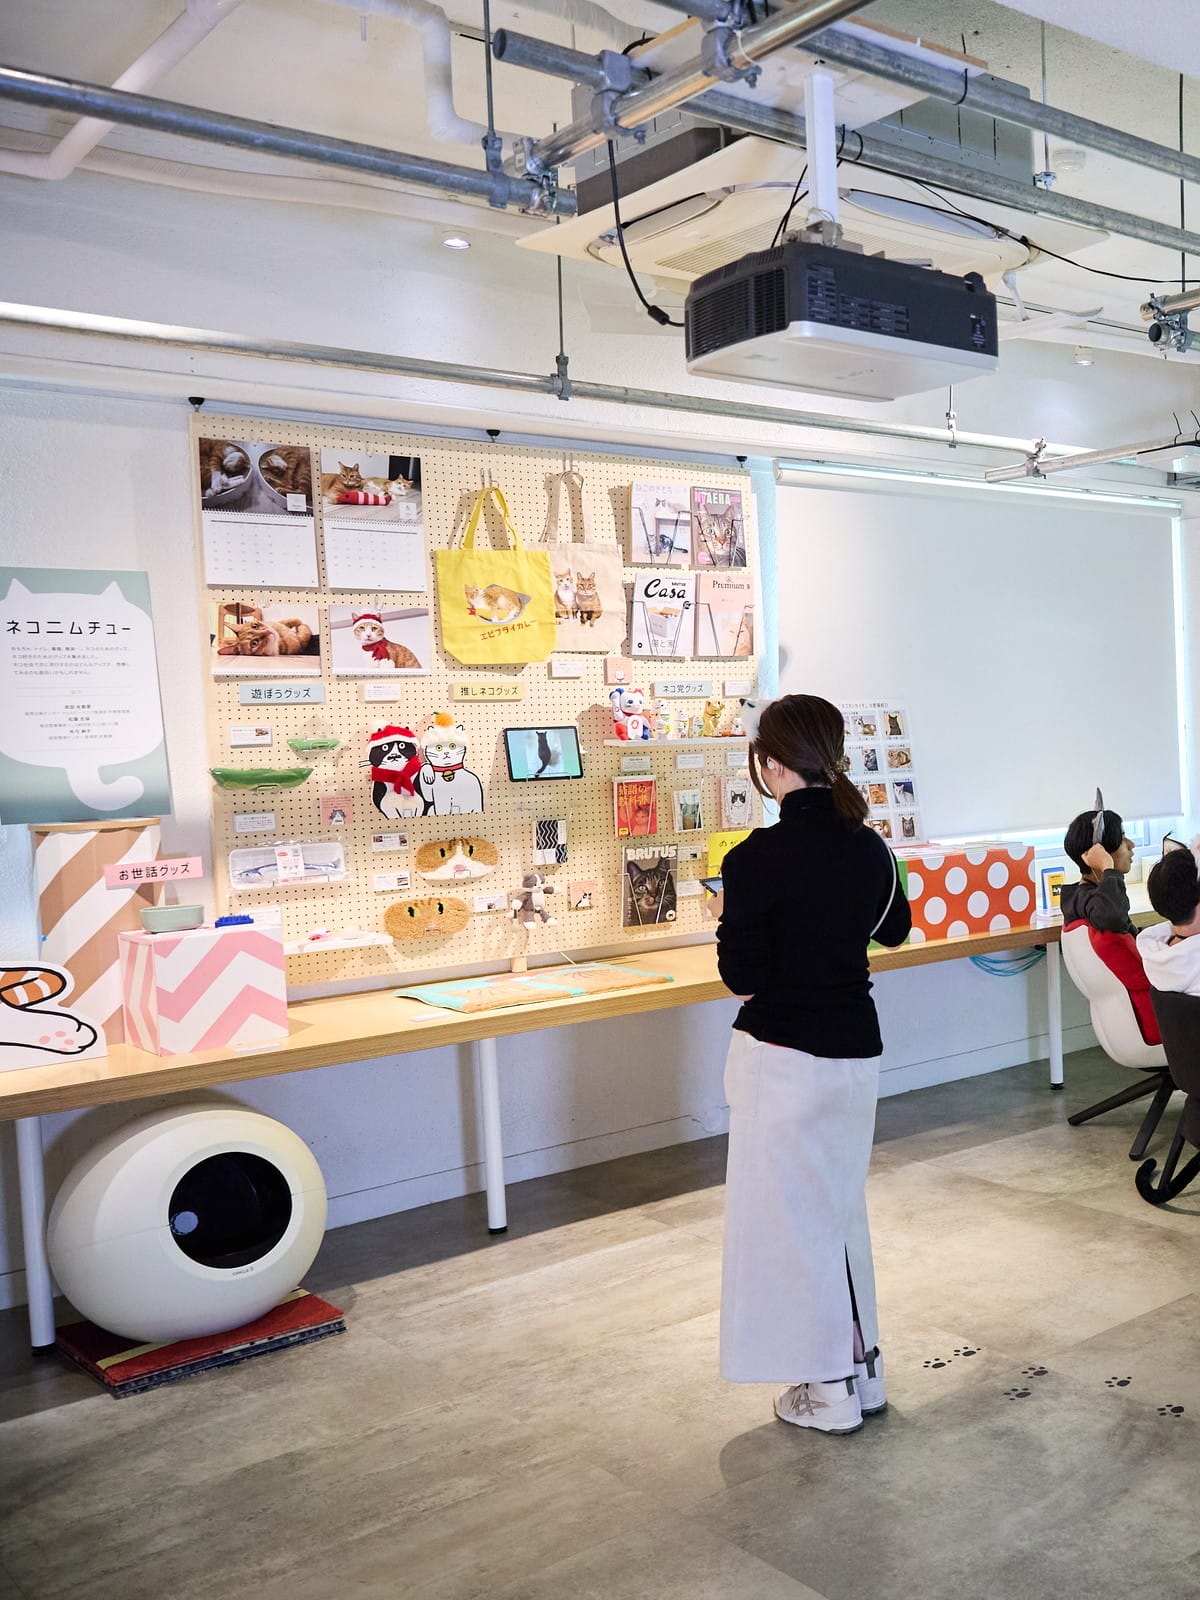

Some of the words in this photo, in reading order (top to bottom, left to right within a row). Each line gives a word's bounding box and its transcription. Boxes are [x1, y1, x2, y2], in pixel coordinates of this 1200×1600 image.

[643, 578, 687, 599] Casa
[712, 580, 745, 591] Premium
[6, 619, 131, 635] ネコニムチュー
[251, 687, 311, 700] 遊ぼうグッズ
[460, 686, 519, 697] 推しネコグッズ
[626, 845, 677, 861] BRUTUS
[119, 862, 190, 881] お世話グッズ
